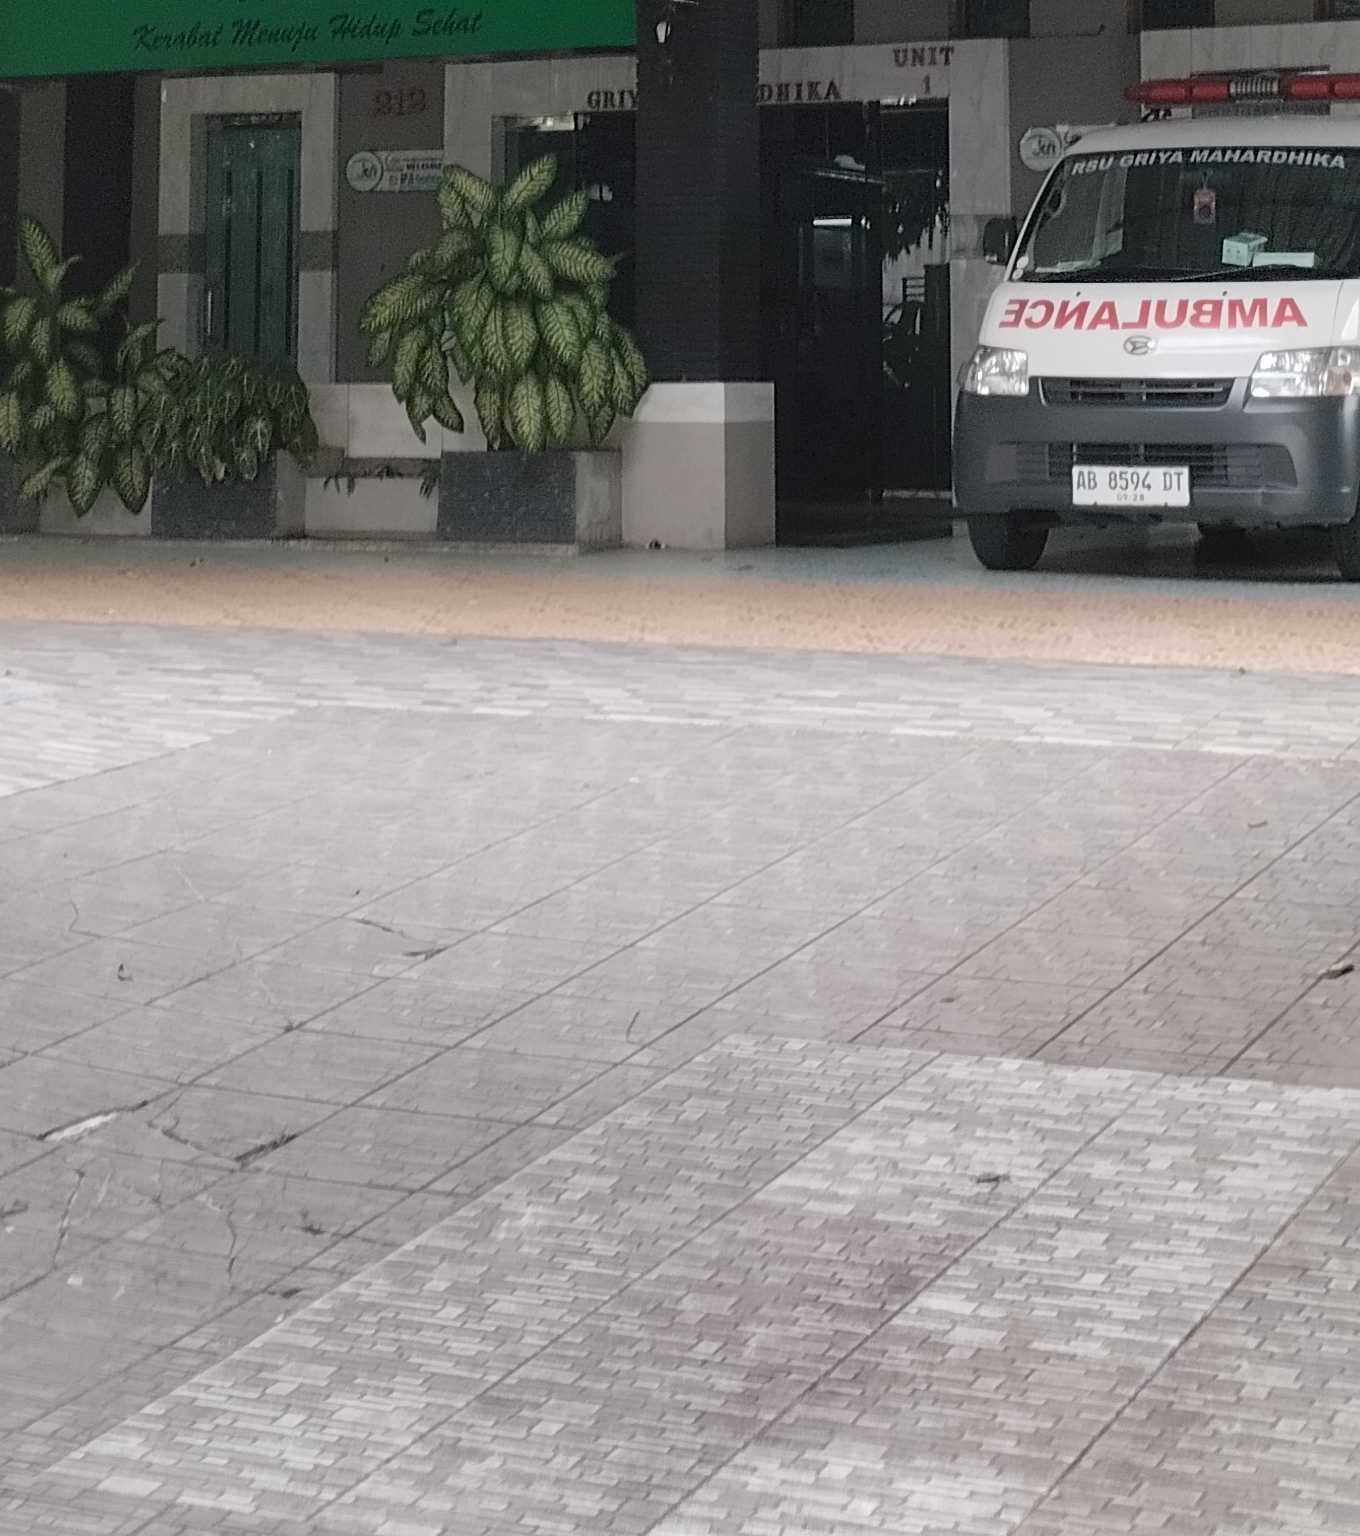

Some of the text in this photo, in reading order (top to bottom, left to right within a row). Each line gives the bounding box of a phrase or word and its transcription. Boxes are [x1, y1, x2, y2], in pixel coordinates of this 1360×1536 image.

[328, 14, 401, 45] Hidup
[411, 8, 483, 37] Sehat
[892, 46, 955, 68] UNIT
[587, 89, 639, 109] GRIY
[1071, 149, 1345, 176] RSU GRIYA MAHARDHIKA
[1077, 470, 1184, 492] AB 8594 DT
